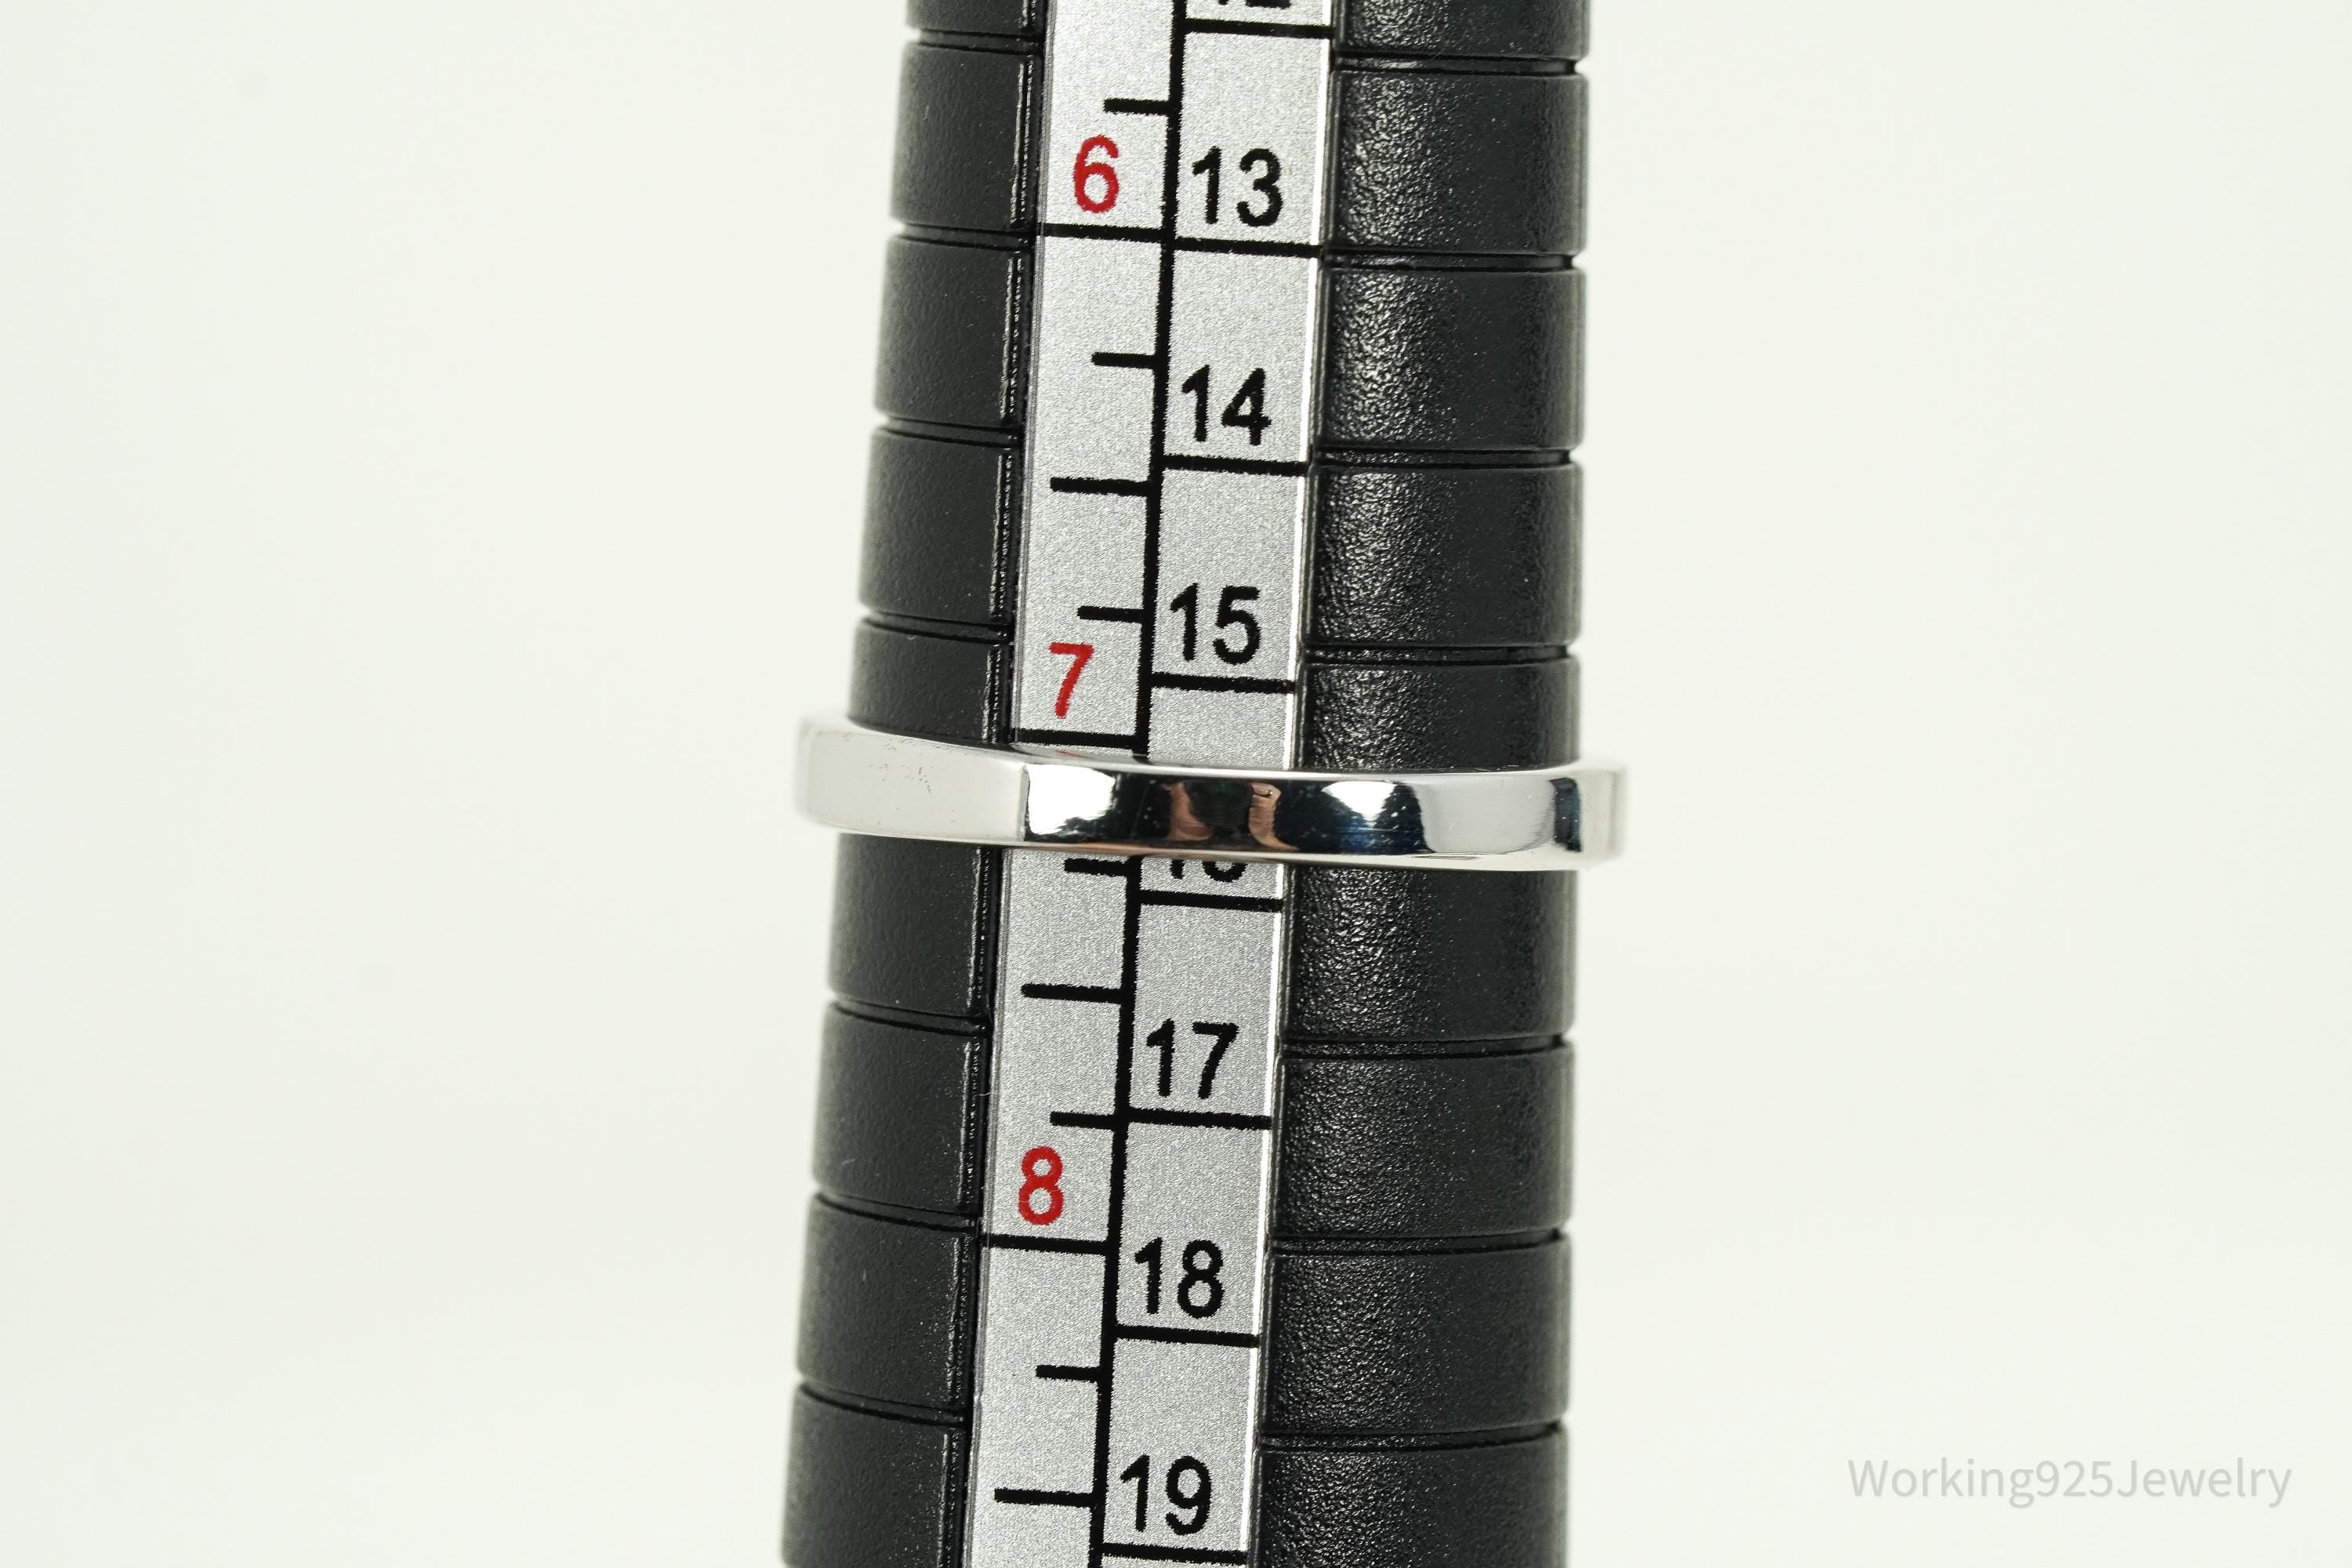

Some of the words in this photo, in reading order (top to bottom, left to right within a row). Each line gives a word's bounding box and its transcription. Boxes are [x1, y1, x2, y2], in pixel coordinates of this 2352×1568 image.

[1072, 133, 1120, 215] 6
[1191, 144, 1284, 229] 13
[1180, 363, 1273, 448] 14
[1168, 581, 1263, 667] 15
[1047, 641, 1095, 719] 7
[1144, 1016, 1241, 1101] 17
[1017, 1145, 1065, 1227] 8
[1131, 1235, 1227, 1321] 18
[1119, 1452, 1215, 1537] 19
